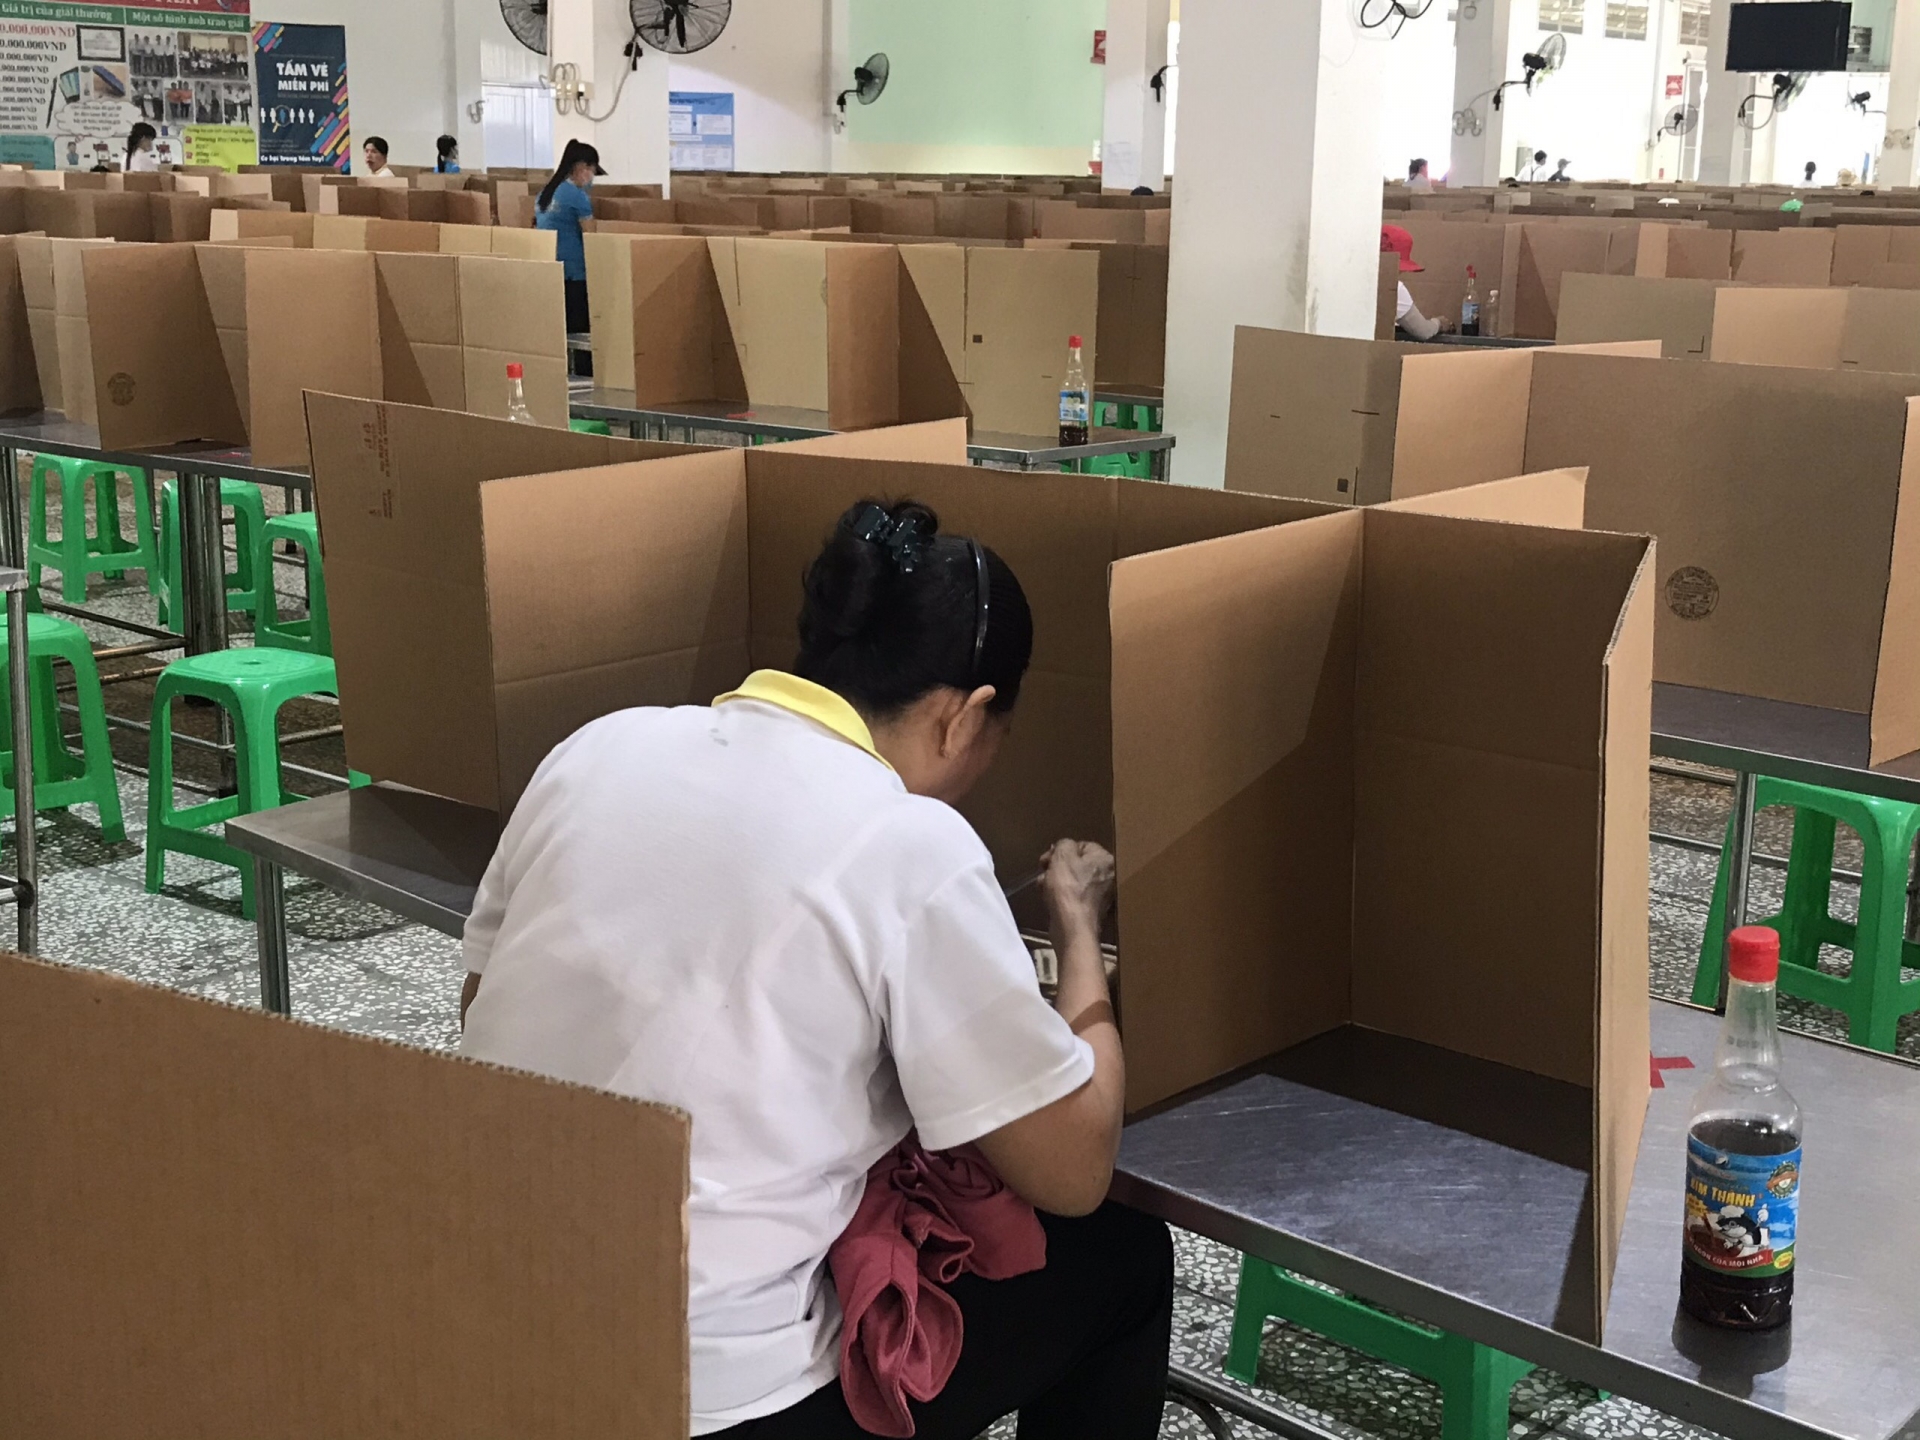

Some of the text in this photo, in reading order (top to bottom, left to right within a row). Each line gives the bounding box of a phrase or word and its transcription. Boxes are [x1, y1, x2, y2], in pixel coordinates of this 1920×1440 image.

[36, 6, 53, 15] của
[75, 8, 112, 21] thưởng
[132, 12, 151, 23] Một
[276, 58, 308, 77] TẤM
[310, 79, 329, 92] PHÍ
